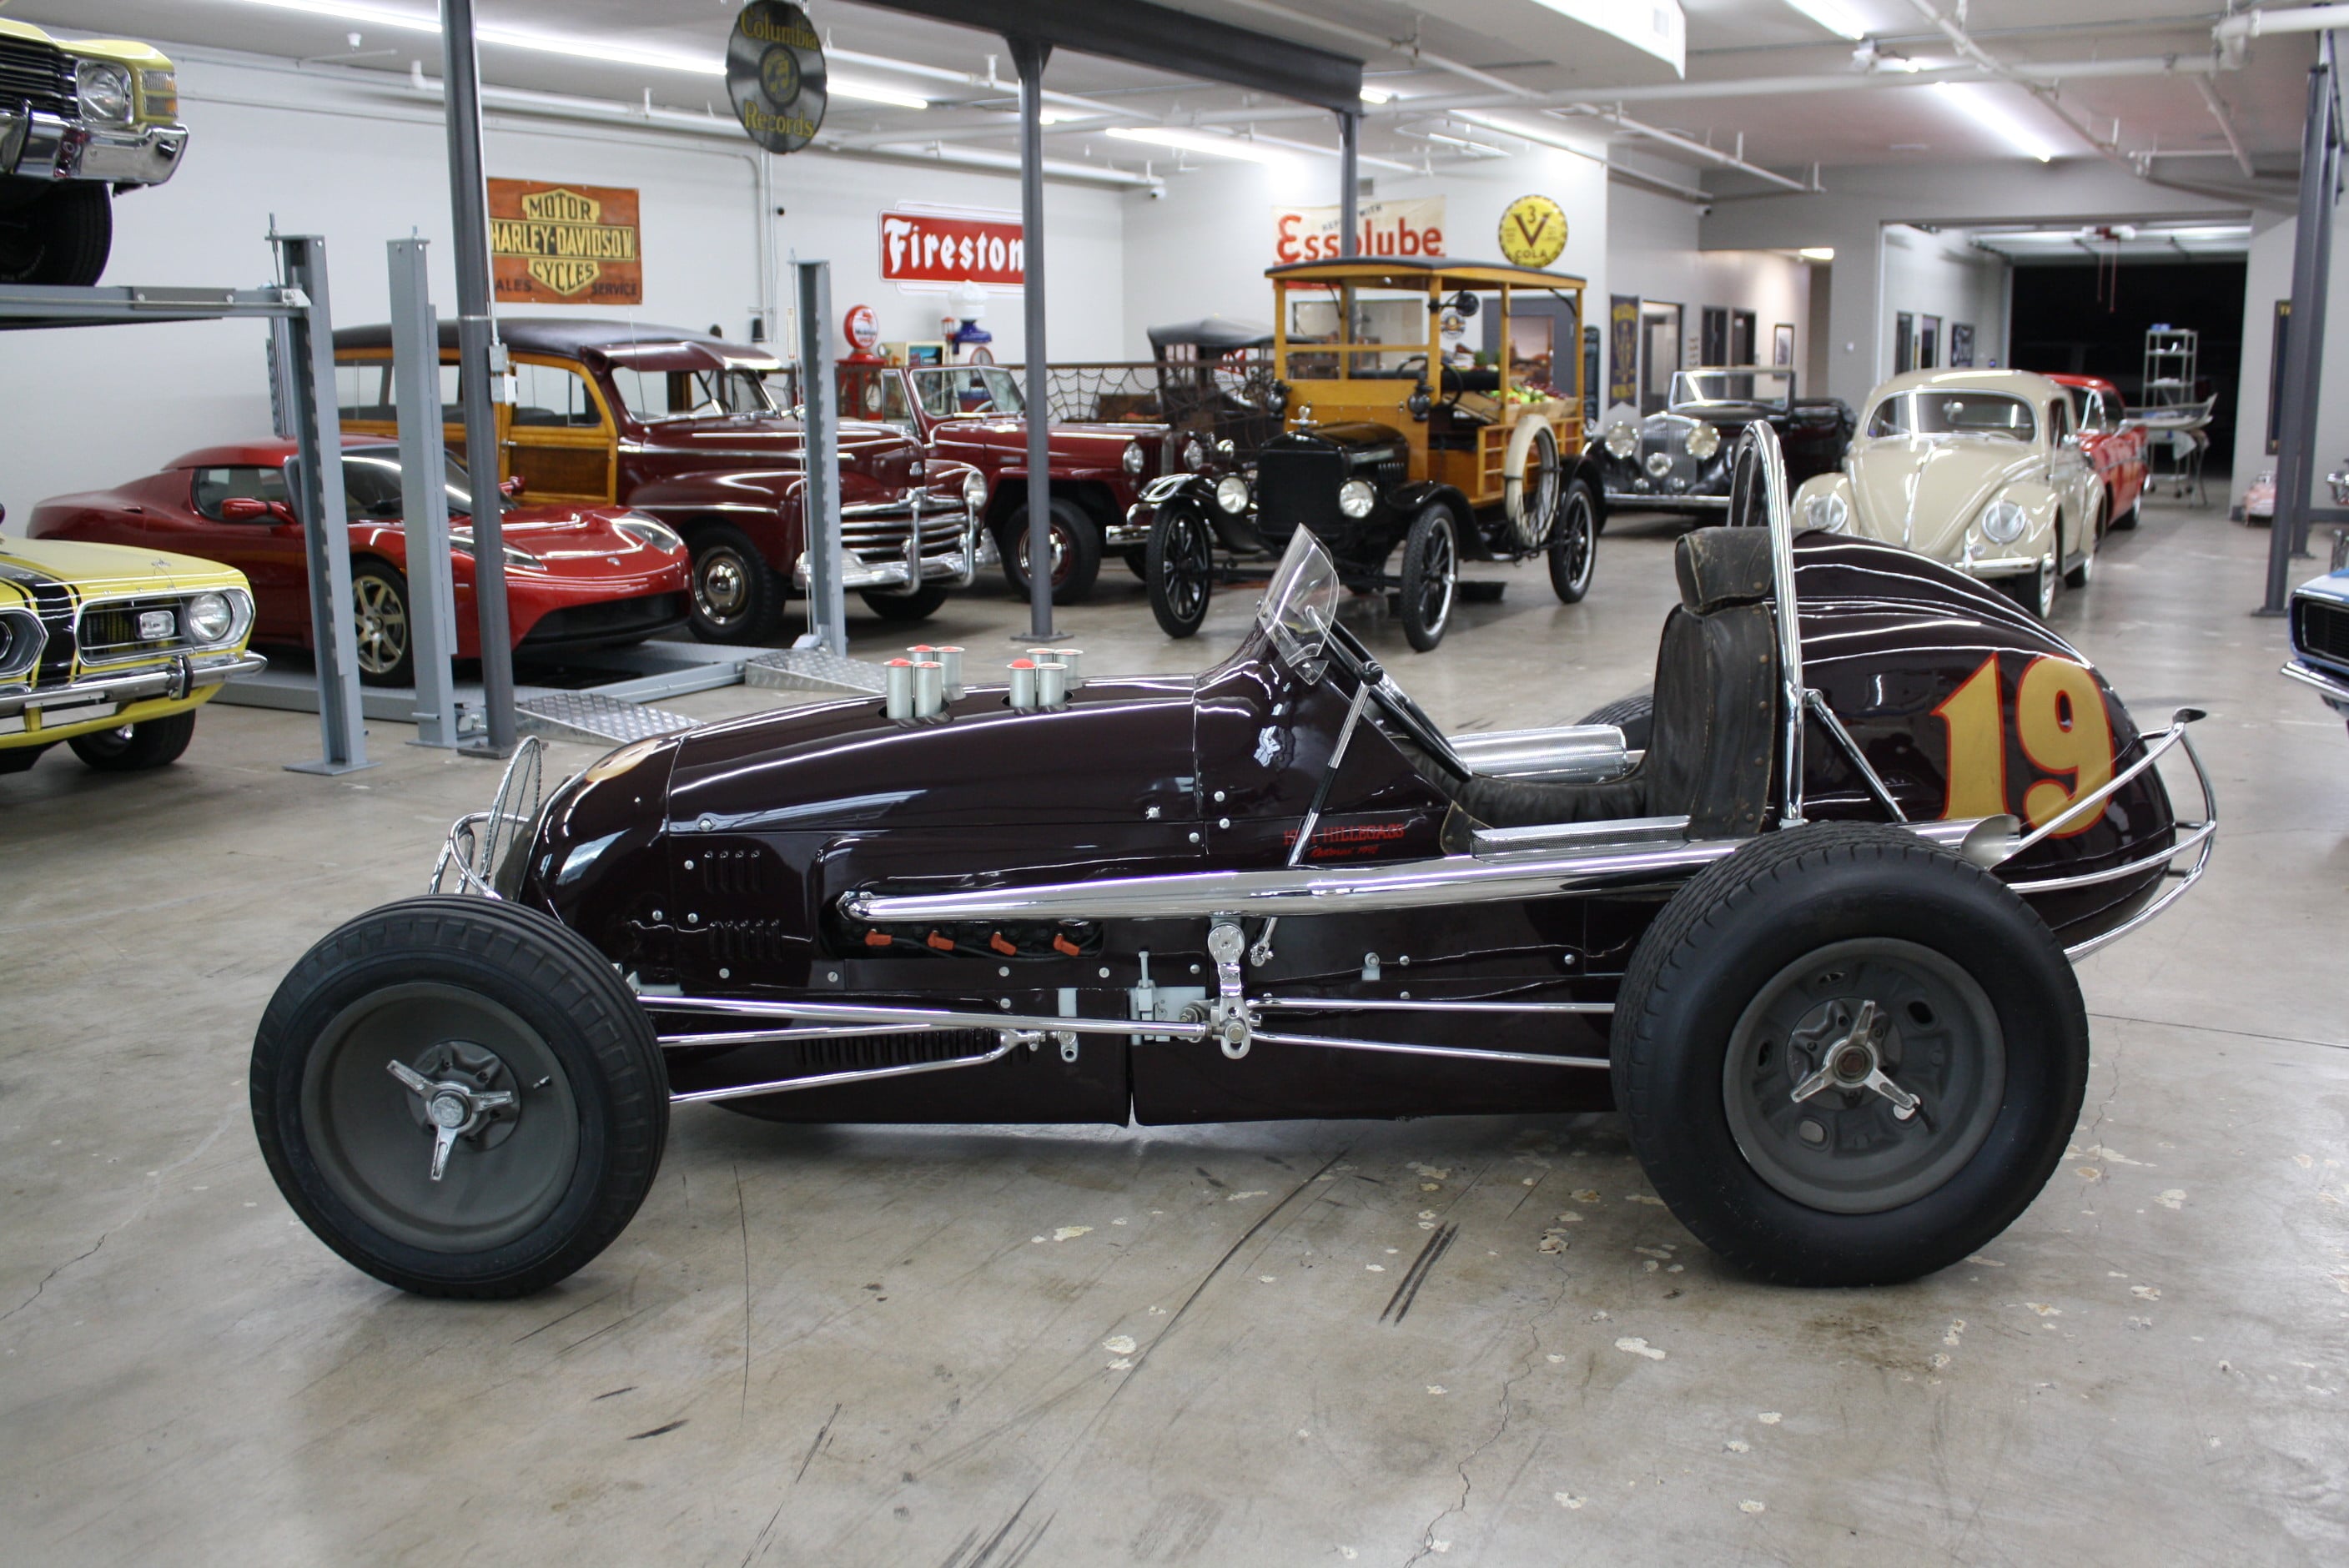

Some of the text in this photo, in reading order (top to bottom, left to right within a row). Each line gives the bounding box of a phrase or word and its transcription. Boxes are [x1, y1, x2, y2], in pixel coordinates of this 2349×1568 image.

[741, 11, 818, 51] Columbia
[744, 100, 814, 138] Records
[528, 193, 592, 220] MOTOR
[1527, 205, 1537, 224] 3
[883, 218, 1024, 274] Fireston
[1276, 214, 1446, 264] Esslube
[1512, 212, 1552, 248] V
[1514, 249, 1548, 259] COLA
[495, 278, 636, 296] ALES SERVICE
[533, 260, 594, 291] CYCLES
[1929, 650, 2116, 839] 19
